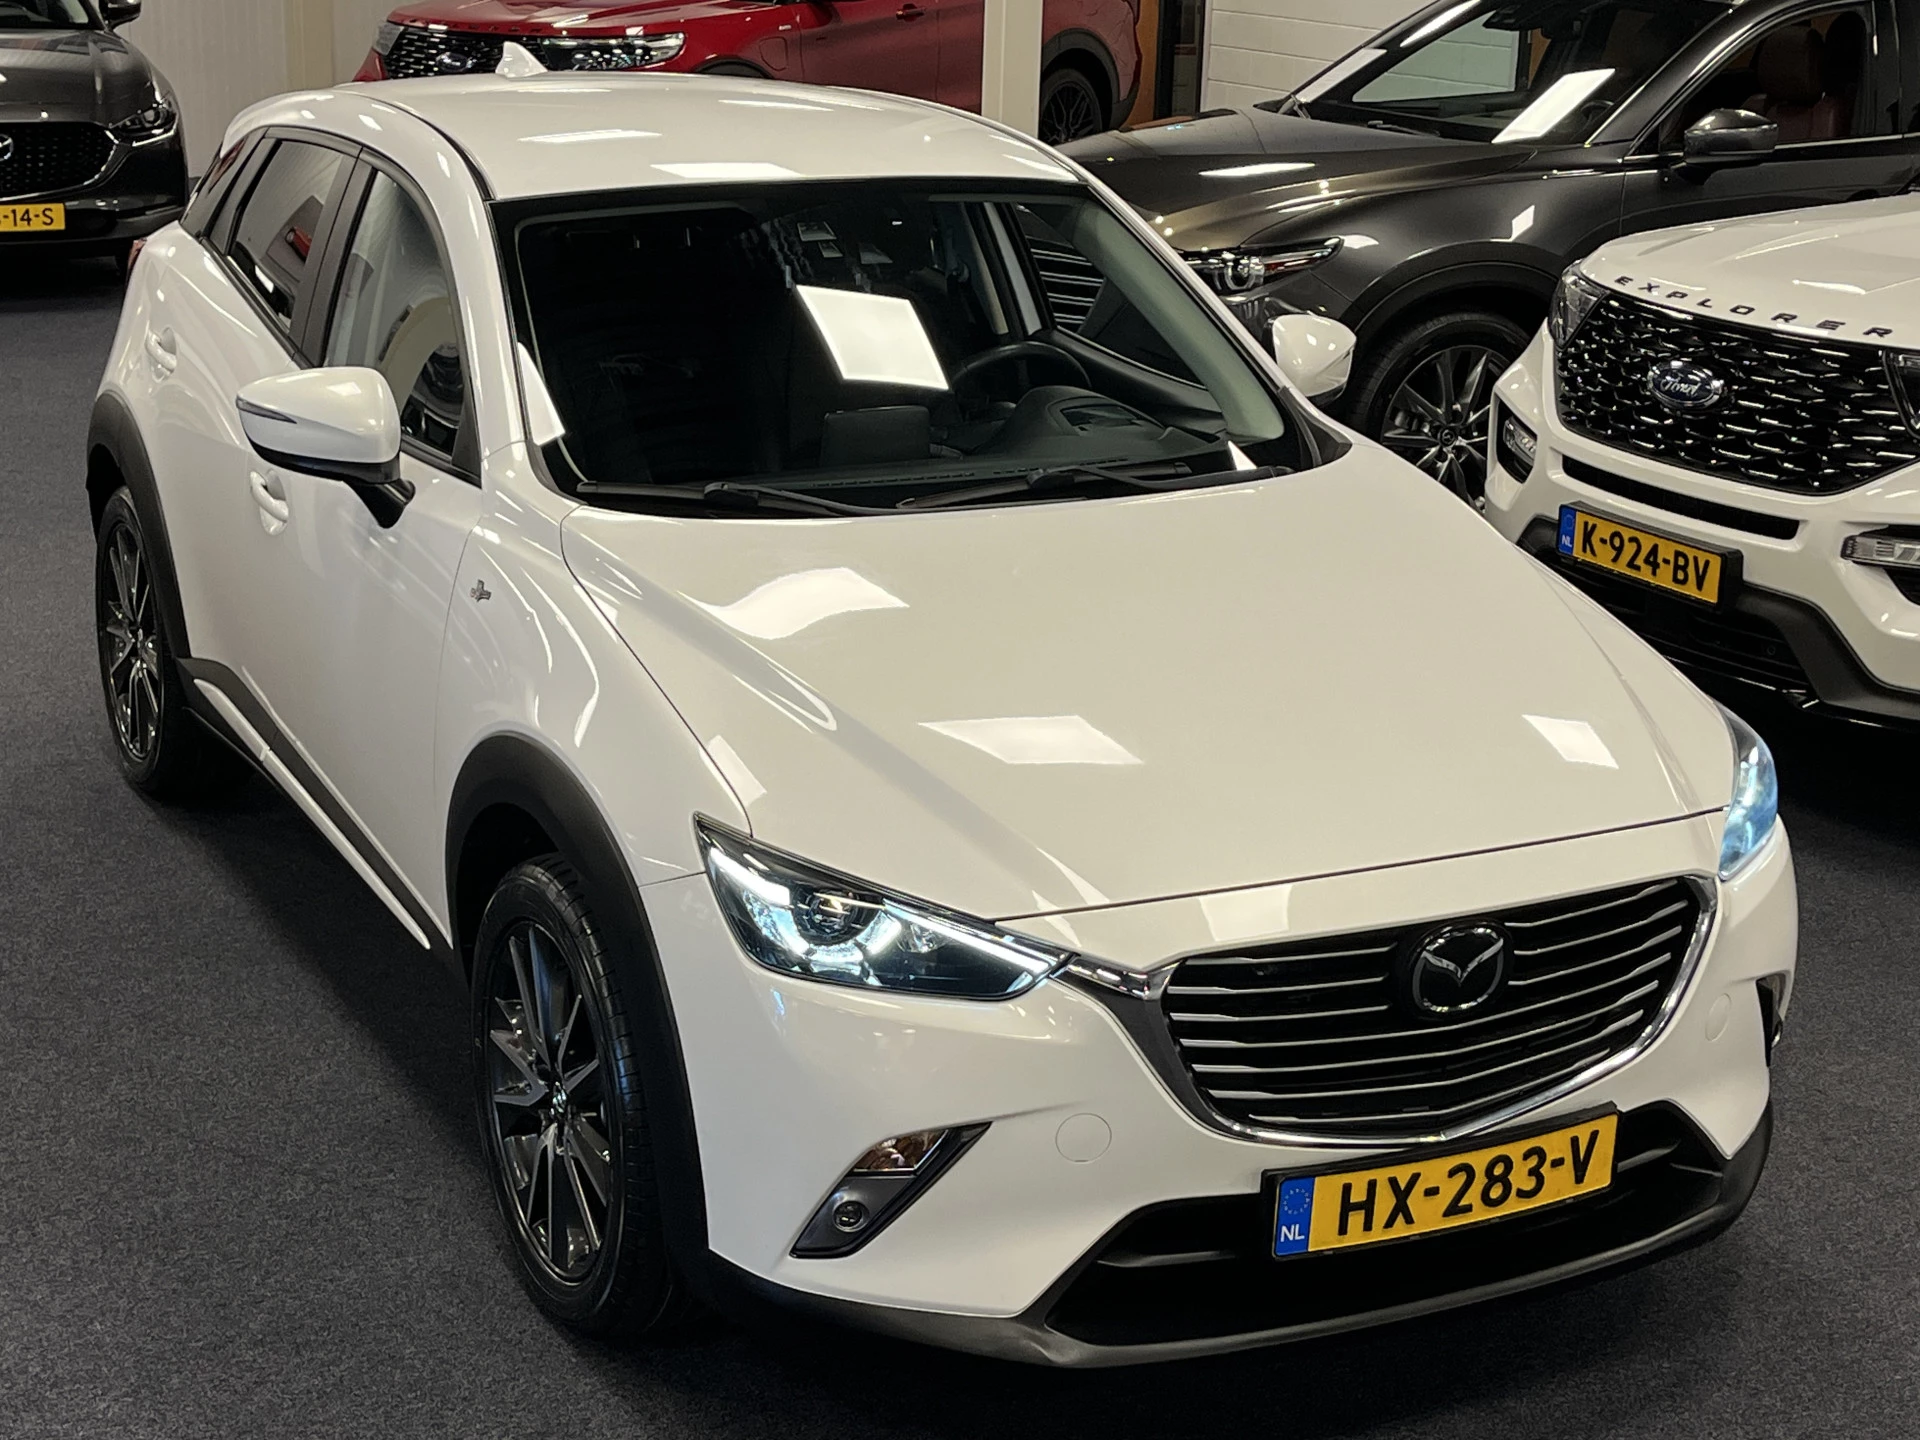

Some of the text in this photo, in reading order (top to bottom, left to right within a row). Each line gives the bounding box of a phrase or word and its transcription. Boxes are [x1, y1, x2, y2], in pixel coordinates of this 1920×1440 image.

[0, 207, 54, 227] -14-S
[1614, 275, 1893, 338] EXPLORER
[1561, 534, 1573, 548] NL
[1581, 520, 1711, 592] K-924-BV
[1337, 1129, 1600, 1237] HX-283-V
[1279, 1223, 1306, 1244] NL
